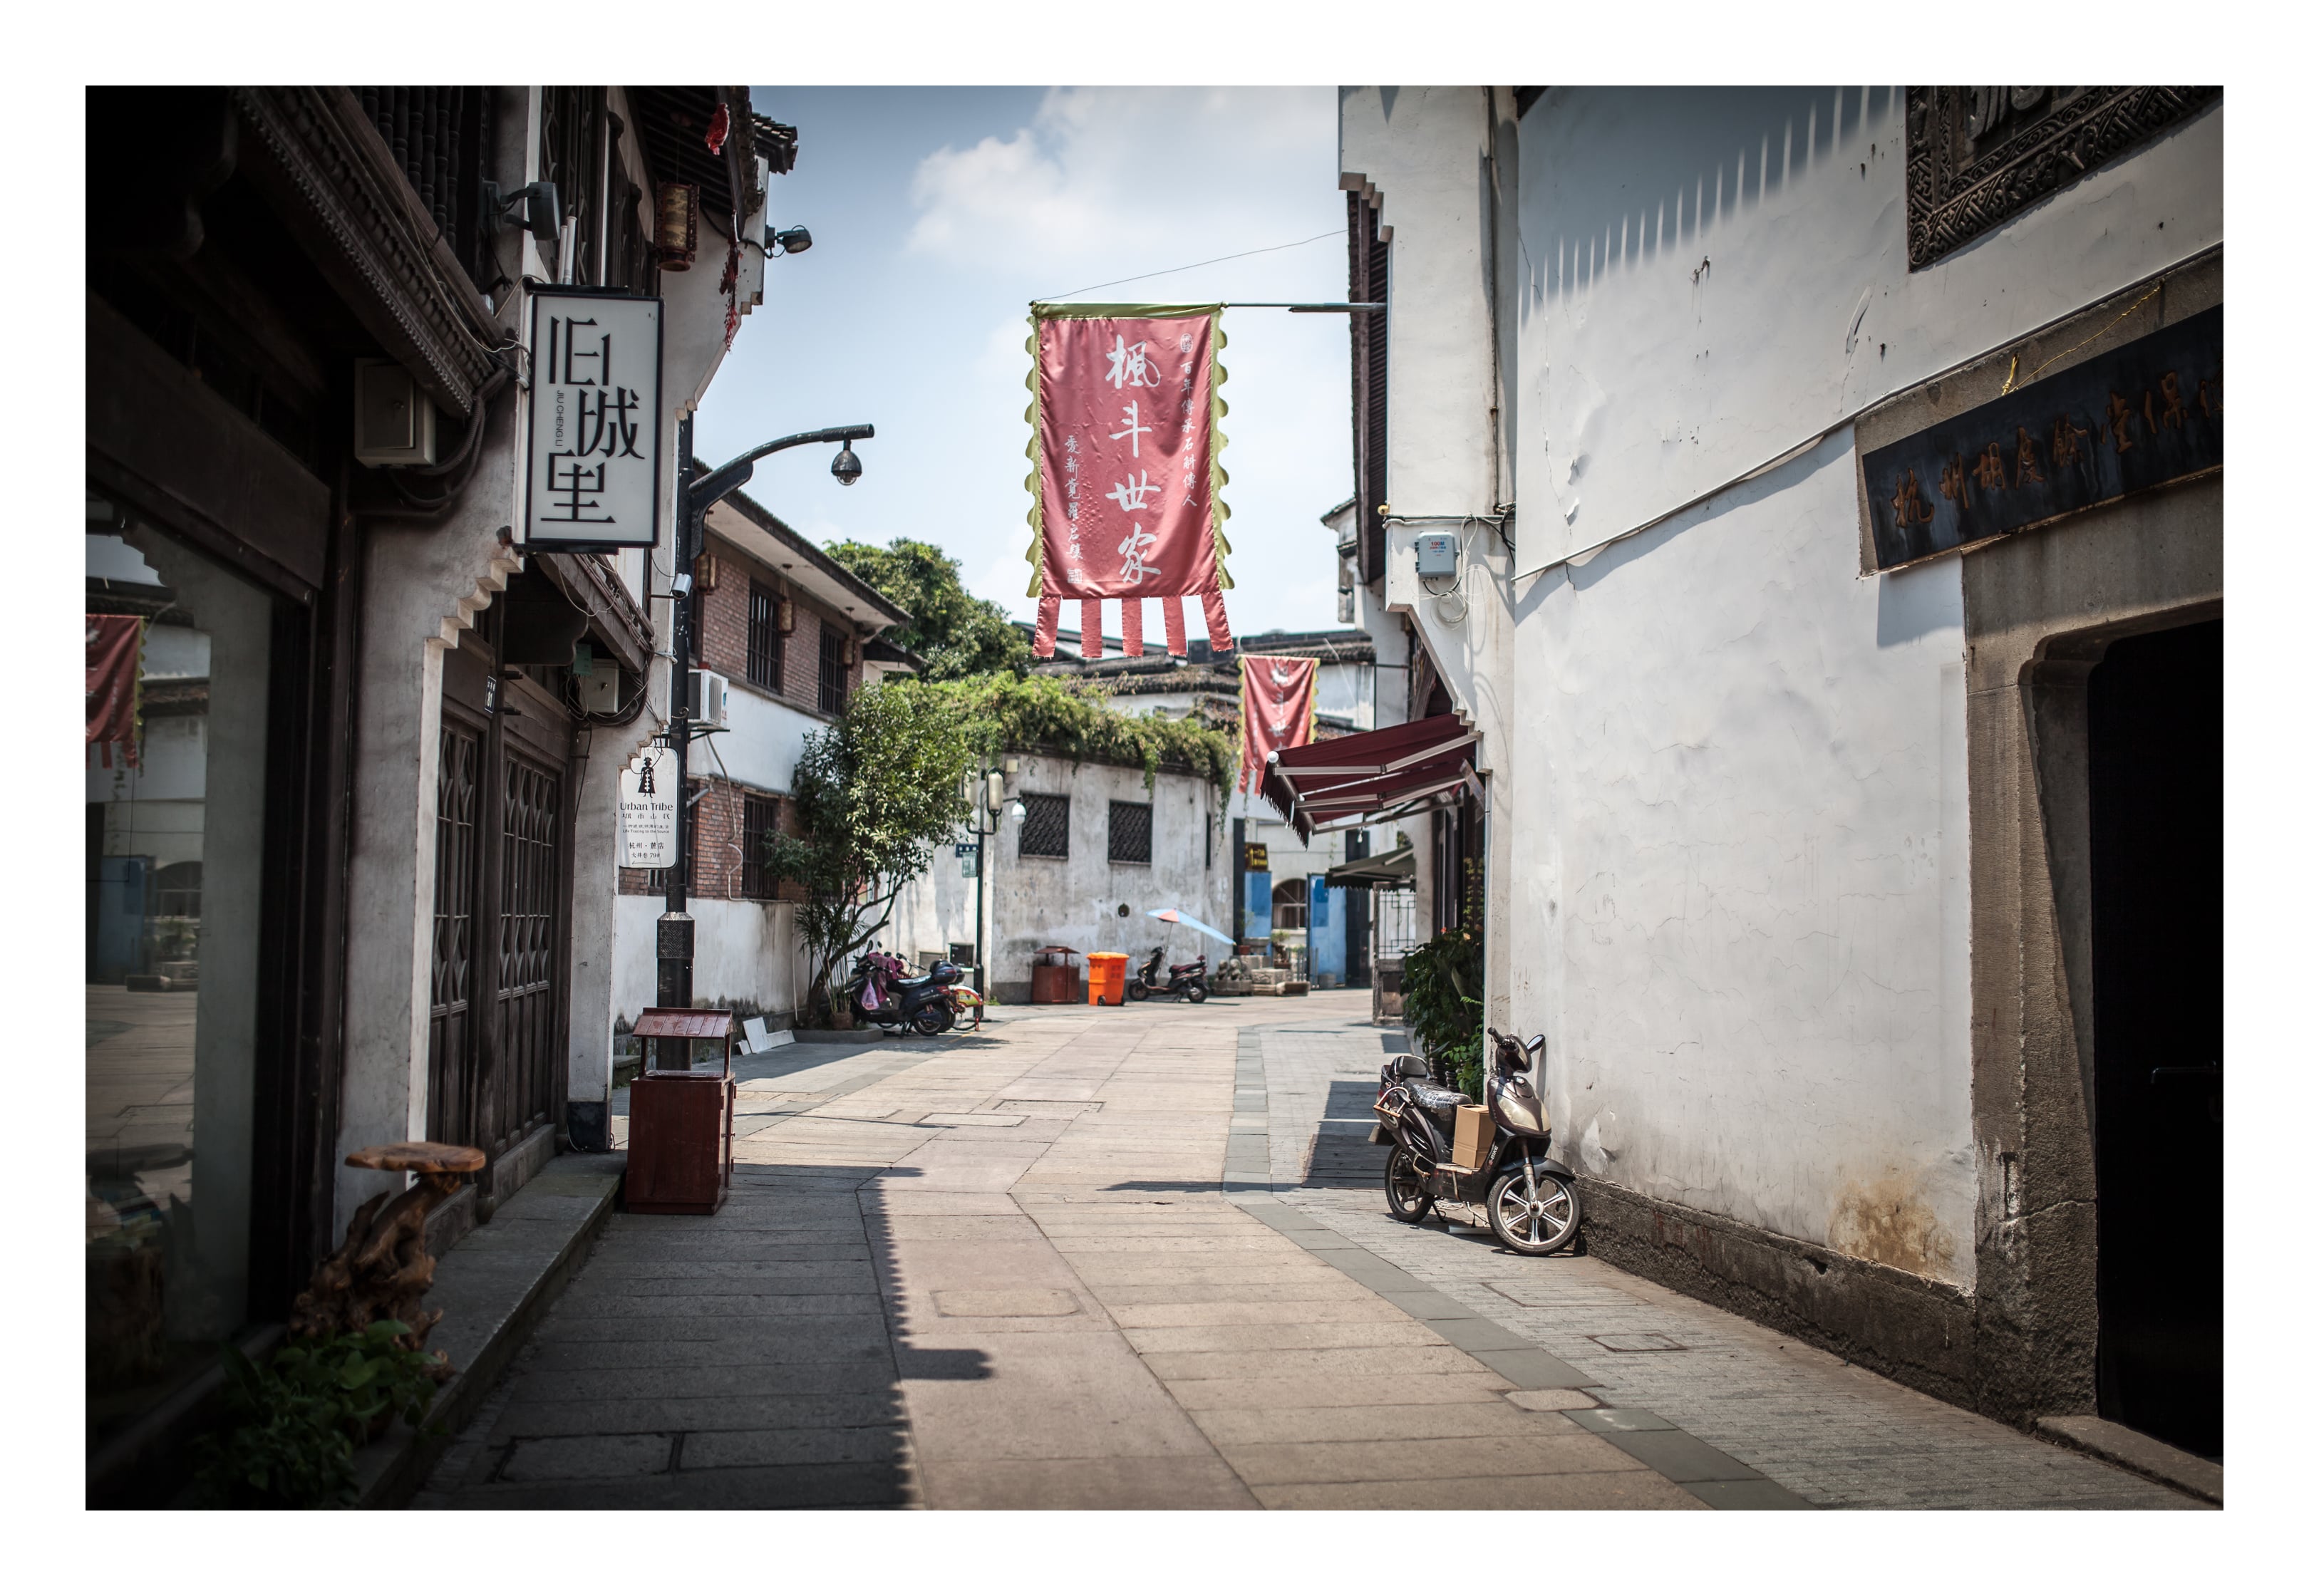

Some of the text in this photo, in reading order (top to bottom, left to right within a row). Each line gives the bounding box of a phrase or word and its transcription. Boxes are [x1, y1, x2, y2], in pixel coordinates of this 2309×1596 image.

[556, 390, 564, 404] JIU
[540, 316, 645, 523] 旧城里
[555, 405, 564, 437] CHENG
[1106, 334, 1161, 584] 楓斗世家
[620, 802, 673, 811] Urban Tribe
